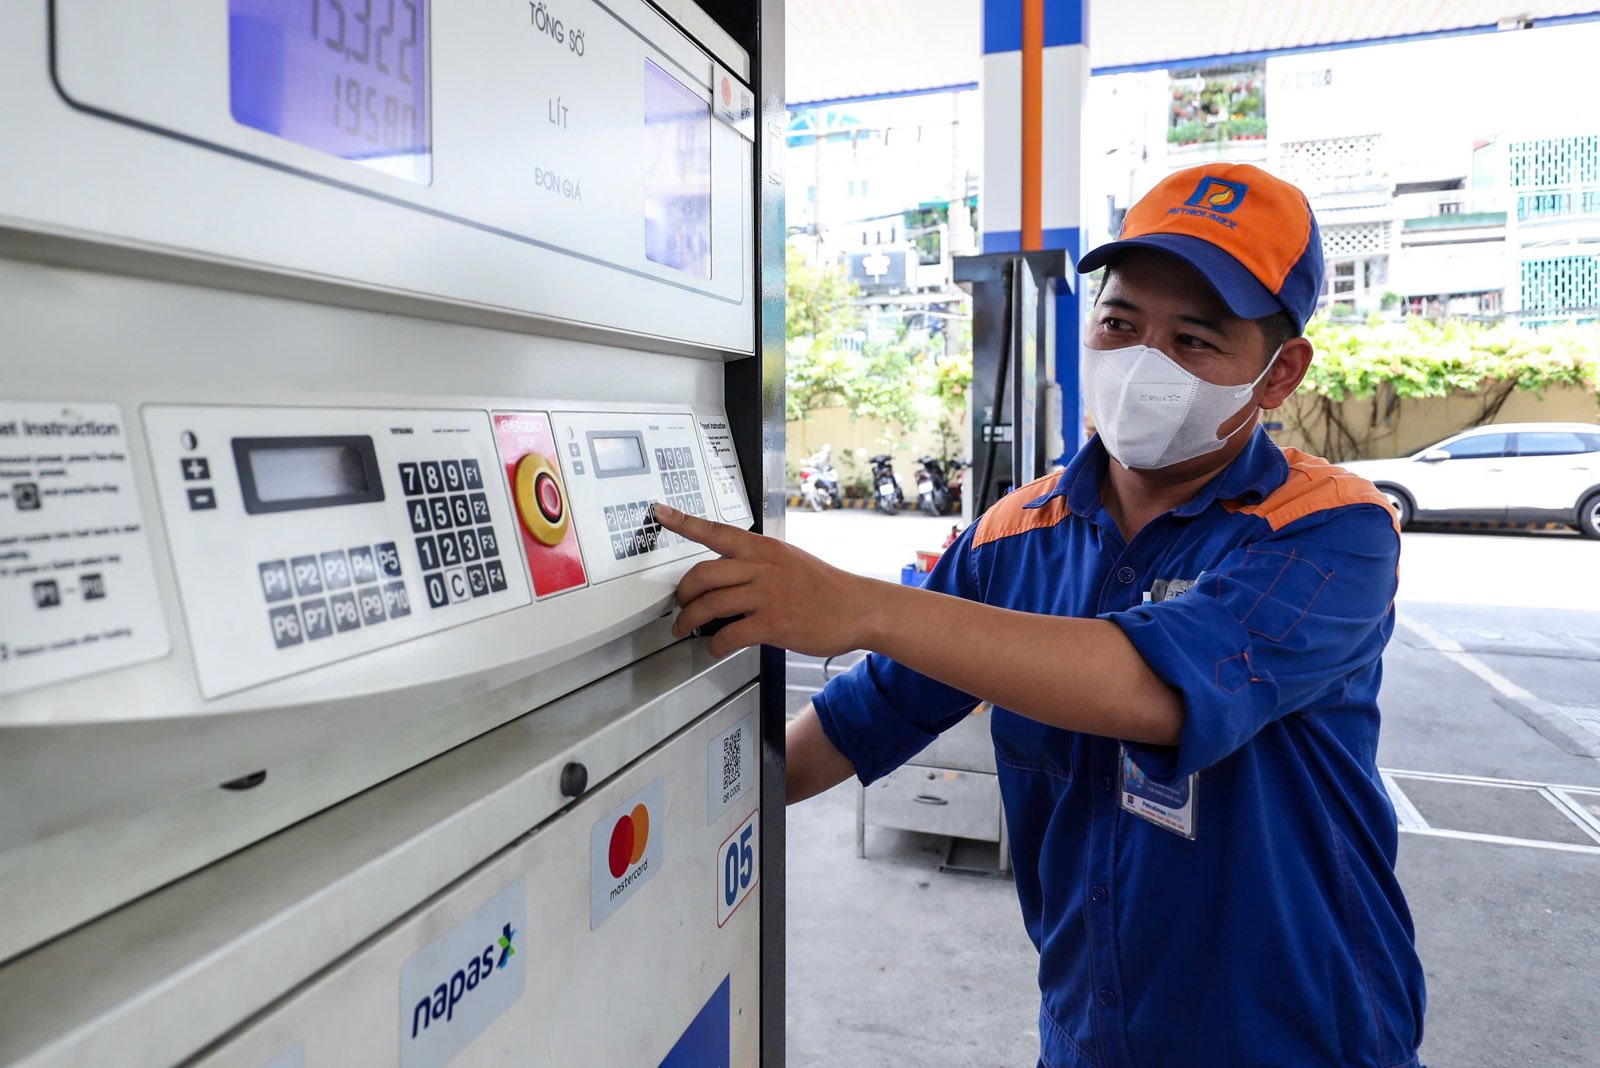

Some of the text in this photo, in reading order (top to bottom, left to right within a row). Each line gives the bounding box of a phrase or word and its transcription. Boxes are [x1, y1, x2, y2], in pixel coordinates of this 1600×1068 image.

[569, 29, 585, 57] SỐ
[548, 96, 568, 129] LÍT
[534, 166, 582, 202] ĐƠN GIÁ
[22, 419, 119, 437] Instruction
[668, 450, 674, 466] 8
[676, 450, 683, 466] 9
[403, 464, 479, 492] 7 8 9 F1
[663, 475, 670, 491] 4
[673, 474, 680, 491] 5
[682, 473, 689, 489] 6
[413, 499, 488, 529] 4 5 6 F2
[606, 511, 617, 526] P1
[618, 509, 629, 524] P2
[630, 508, 640, 522] P3
[421, 534, 496, 567] 1 2 3 F3
[613, 540, 624, 555] P6
[625, 537, 634, 552] P7
[636, 534, 647, 549] P8
[647, 532, 656, 546] P9
[262, 550, 399, 595] P1 P2 P3 P4 P5
[430, 568, 504, 604] 0 C F4
[272, 588, 410, 642] P6 P7 P8 P9 P10
[723, 782, 741, 804] QR CODE
[610, 859, 648, 901] mastercard
[725, 823, 753, 906] 05
[411, 944, 495, 1039] napas
